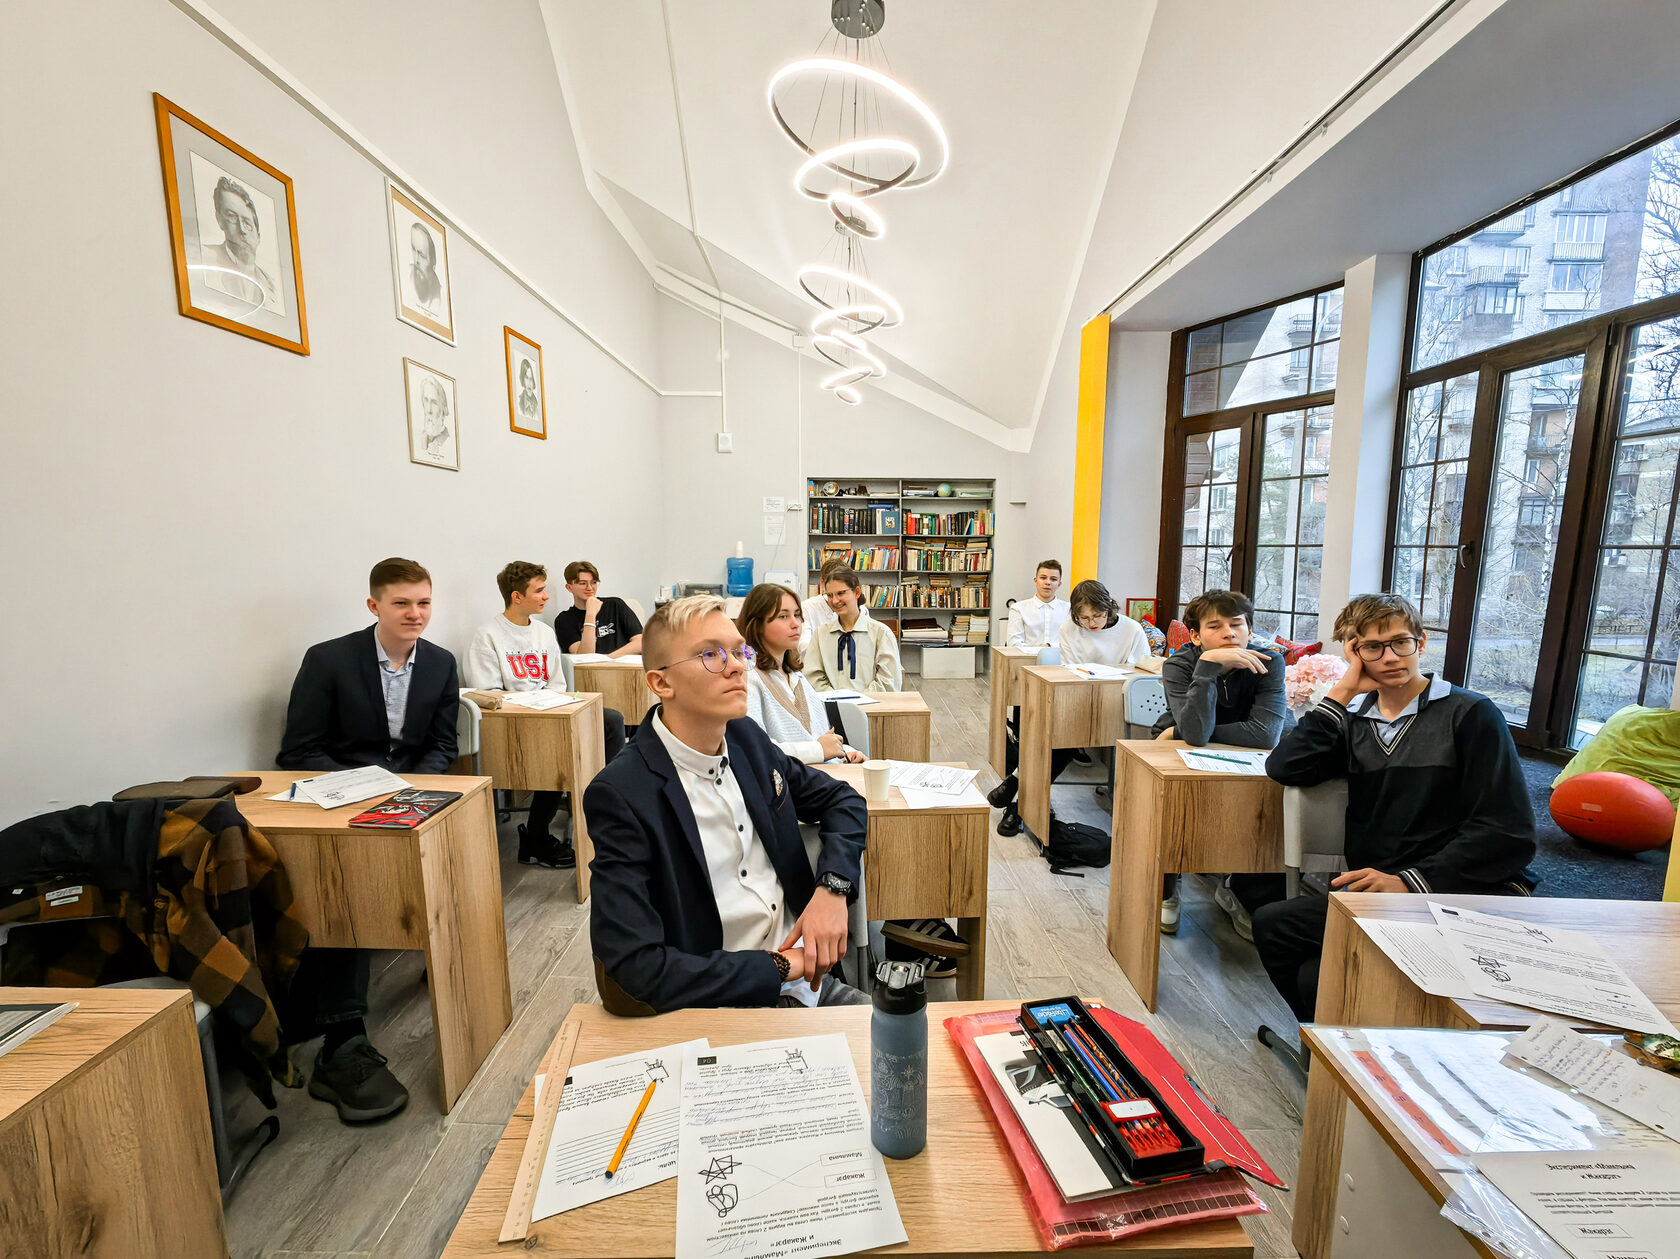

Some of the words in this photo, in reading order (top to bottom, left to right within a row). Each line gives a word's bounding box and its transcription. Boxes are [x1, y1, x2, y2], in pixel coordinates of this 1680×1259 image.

[828, 1150, 862, 1163] Мамлына
[835, 1171, 865, 1183] Жакарэг
[790, 1238, 841, 1255] Эксперимент
